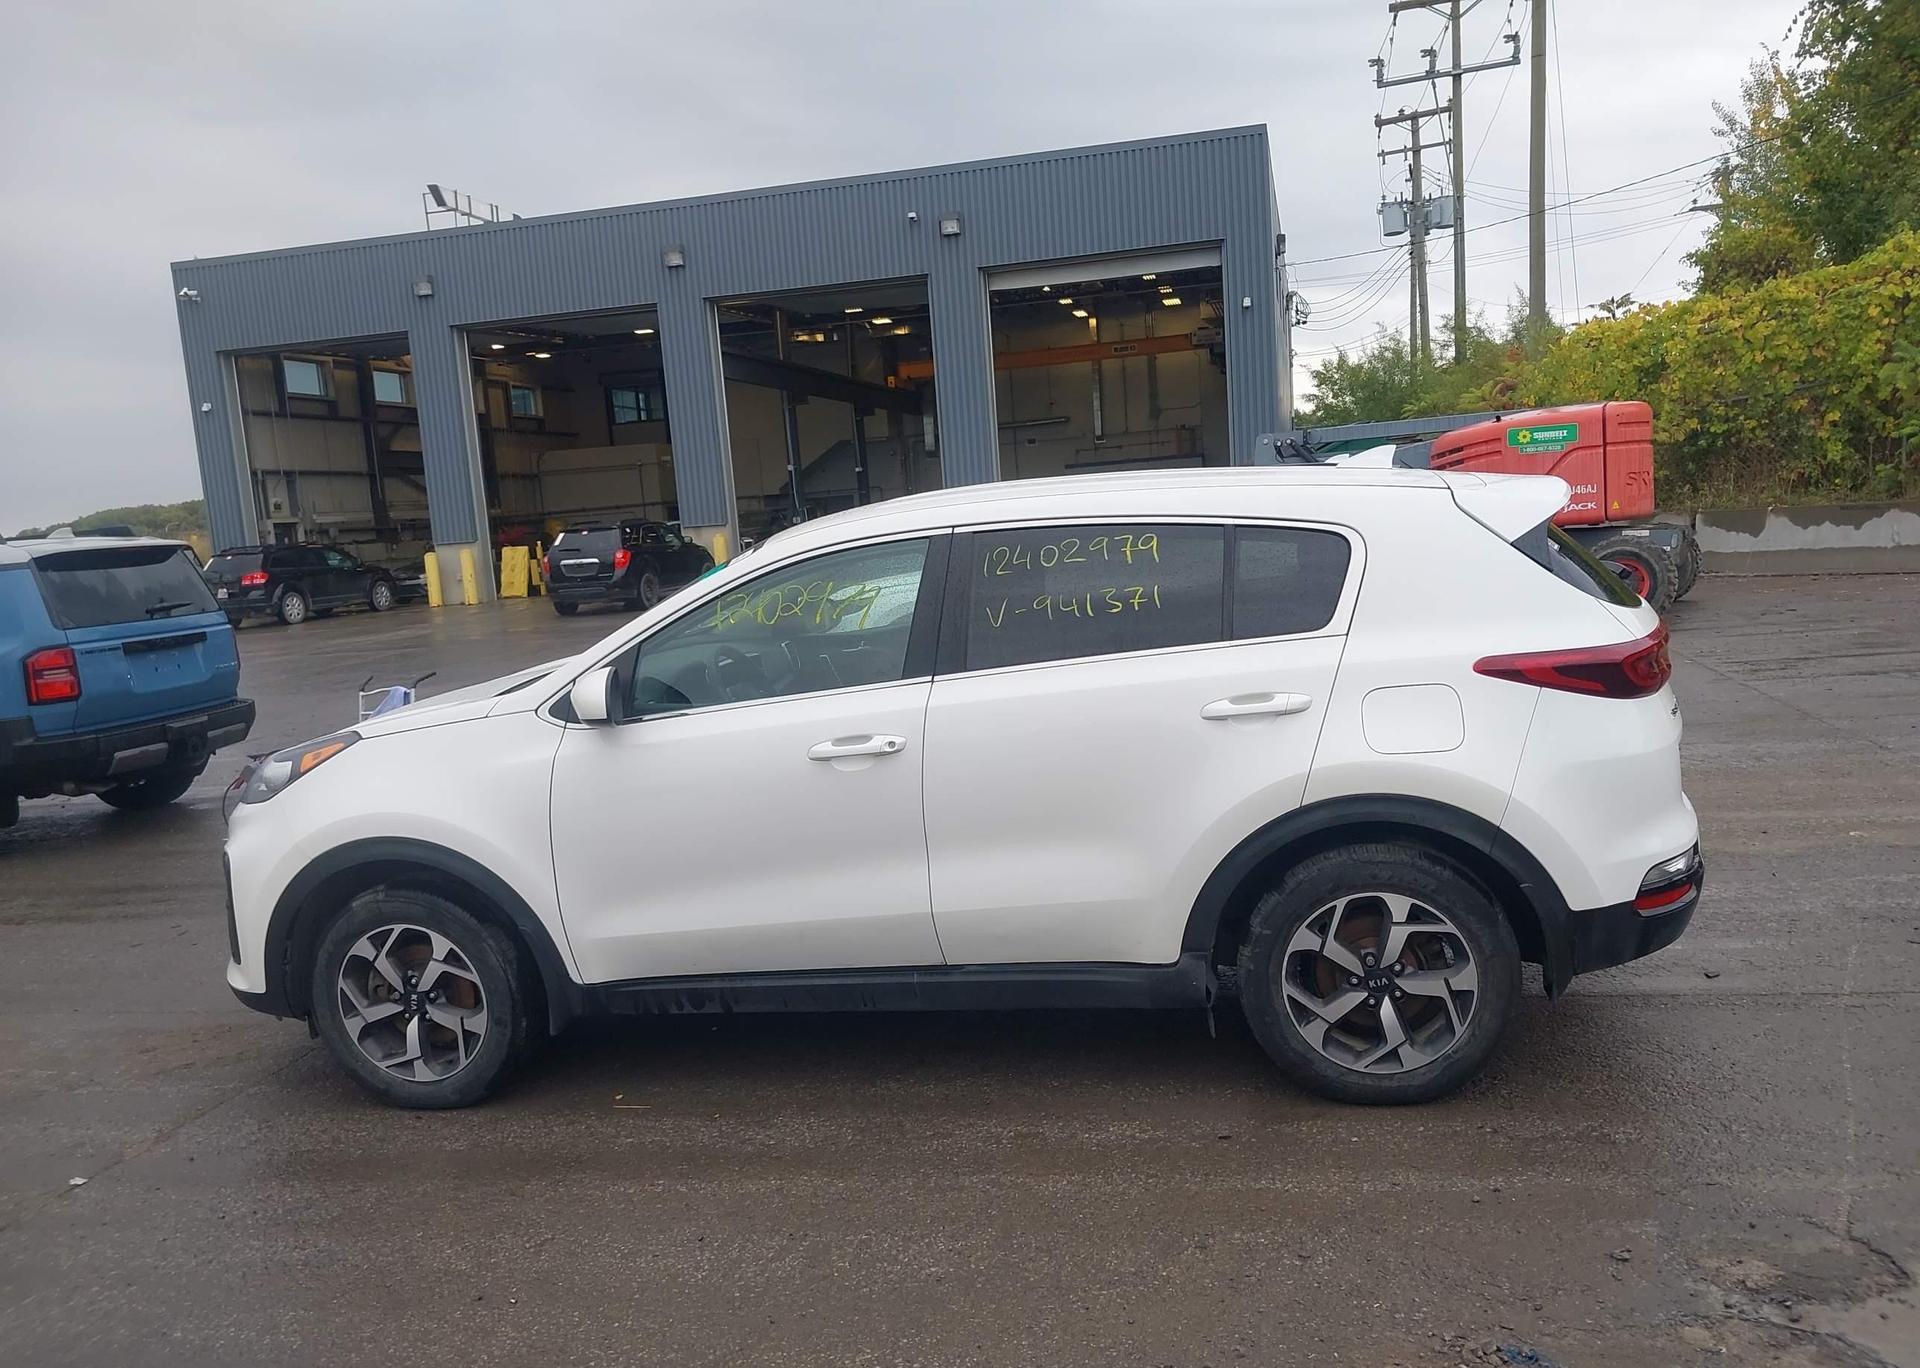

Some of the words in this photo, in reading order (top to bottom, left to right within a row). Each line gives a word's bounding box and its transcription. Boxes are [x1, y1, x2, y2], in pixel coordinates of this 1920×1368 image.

[1570, 483, 1597, 495] J46AJ
[1562, 501, 1597, 513] JACK
[983, 533, 1160, 577] 12402979
[985, 585, 1161, 628] V-941371
[1368, 977, 1389, 988] KIA
[410, 994, 418, 1010] KIA
